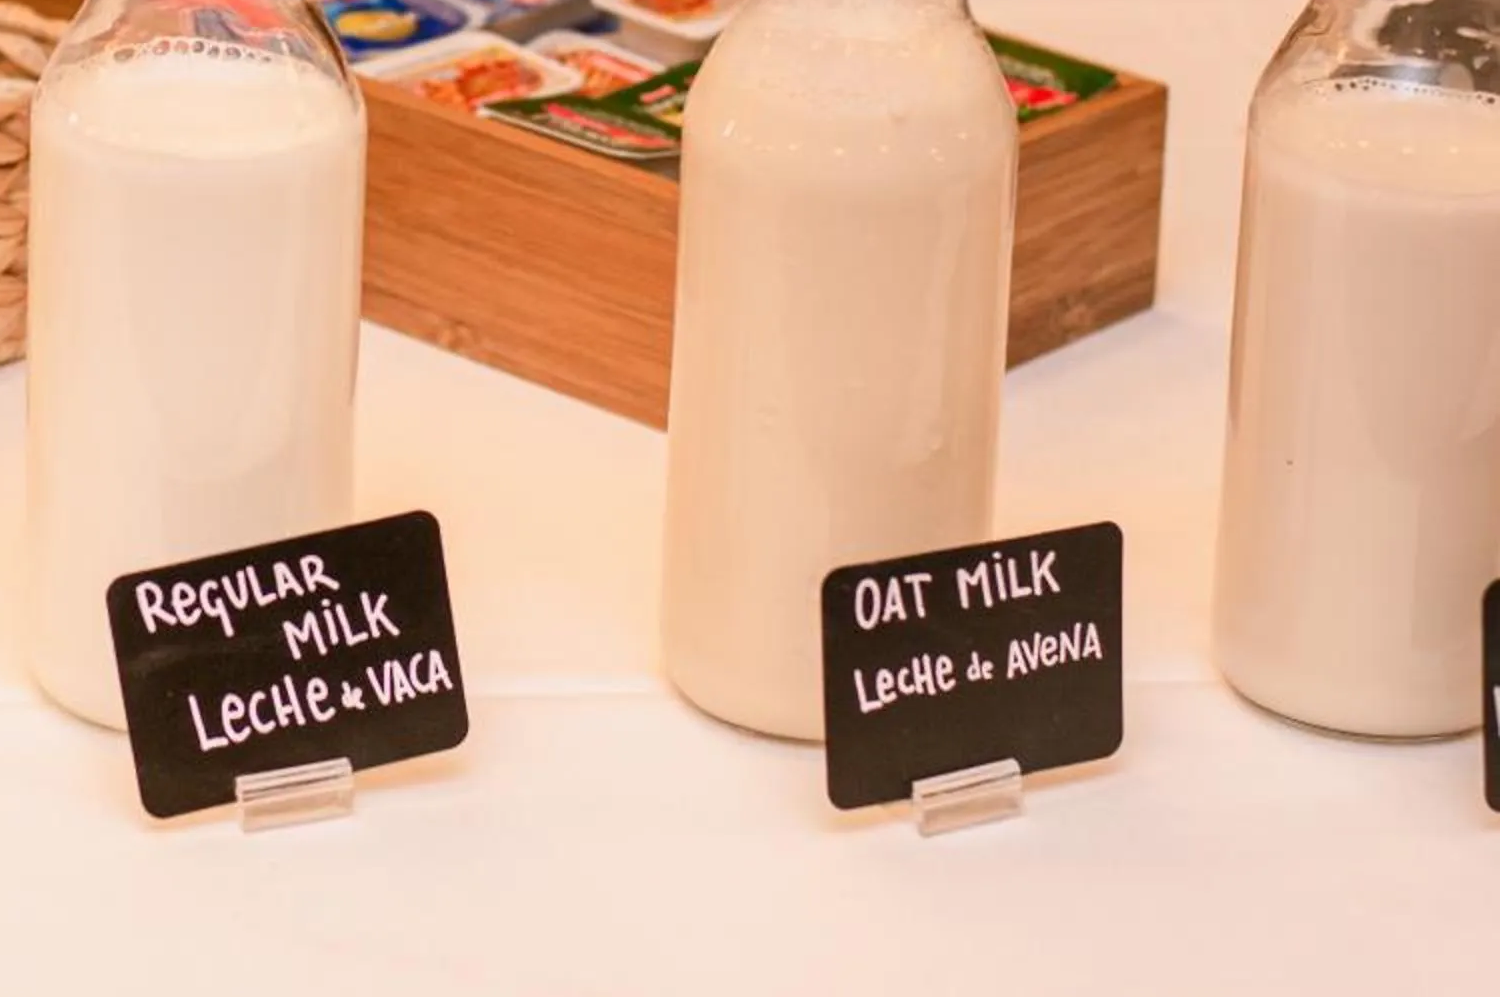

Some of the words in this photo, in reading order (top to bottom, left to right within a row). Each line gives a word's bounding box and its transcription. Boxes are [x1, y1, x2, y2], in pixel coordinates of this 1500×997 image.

[854, 572, 933, 631] OAT
[365, 648, 454, 707] VACA
[966, 651, 994, 682] de
